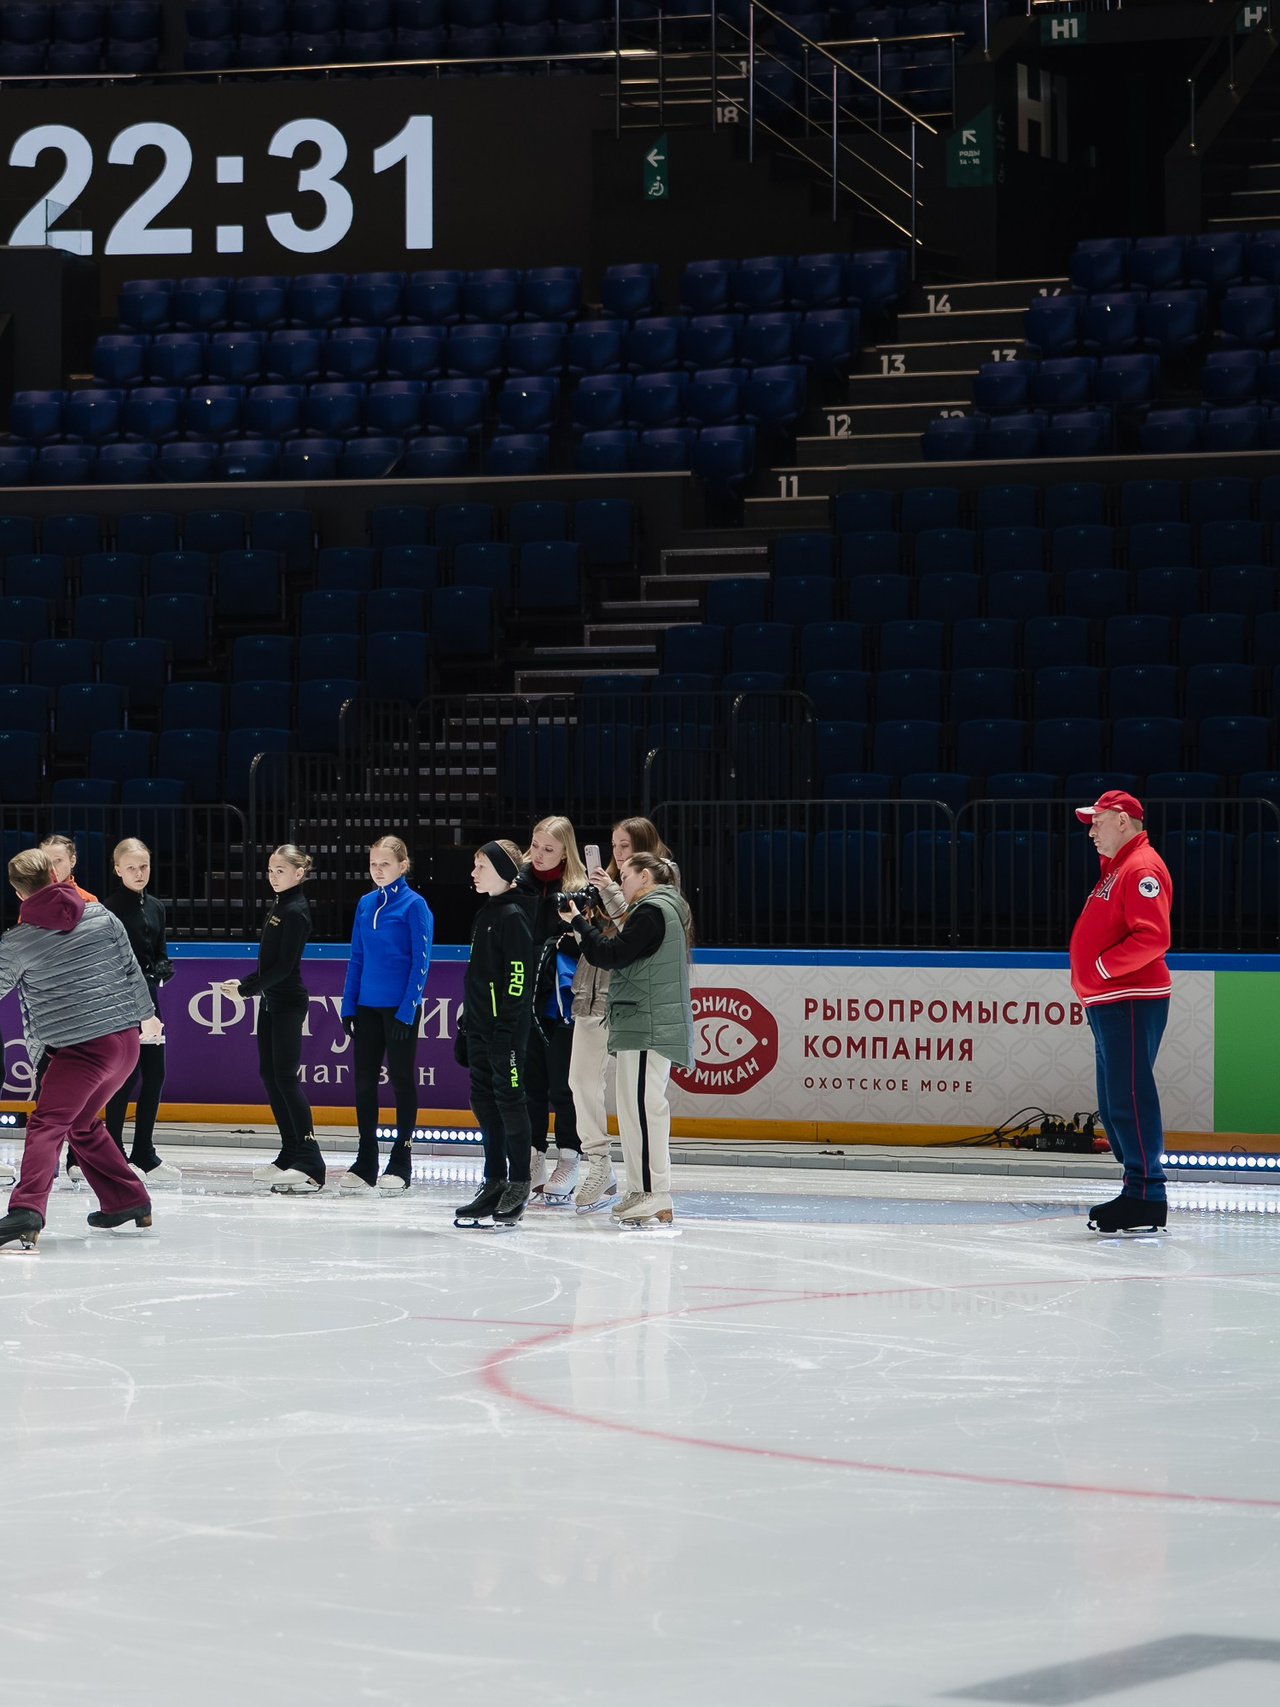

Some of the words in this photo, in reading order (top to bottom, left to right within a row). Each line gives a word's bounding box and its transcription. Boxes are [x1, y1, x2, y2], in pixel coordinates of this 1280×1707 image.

[1051, 18, 1079, 40] H1
[1244, 6, 1268, 28] H
[716, 106, 739, 124] 18
[927, 294, 952, 315] 14
[880, 354, 907, 376] 13
[827, 414, 853, 438] 12
[778, 475, 799, 499] 11
[508, 961, 525, 997] PRO
[690, 996, 752, 1021] ОНИКО
[804, 998, 1091, 1026] РЫБОПРОМЫСЛОВ
[804, 1035, 974, 1062] КОМПАНИЯ
[677, 1057, 760, 1087] УМИКАН
[804, 1077, 909, 1092] ОХОТСКОЕ
[921, 1079, 973, 1093] МОРЕ
